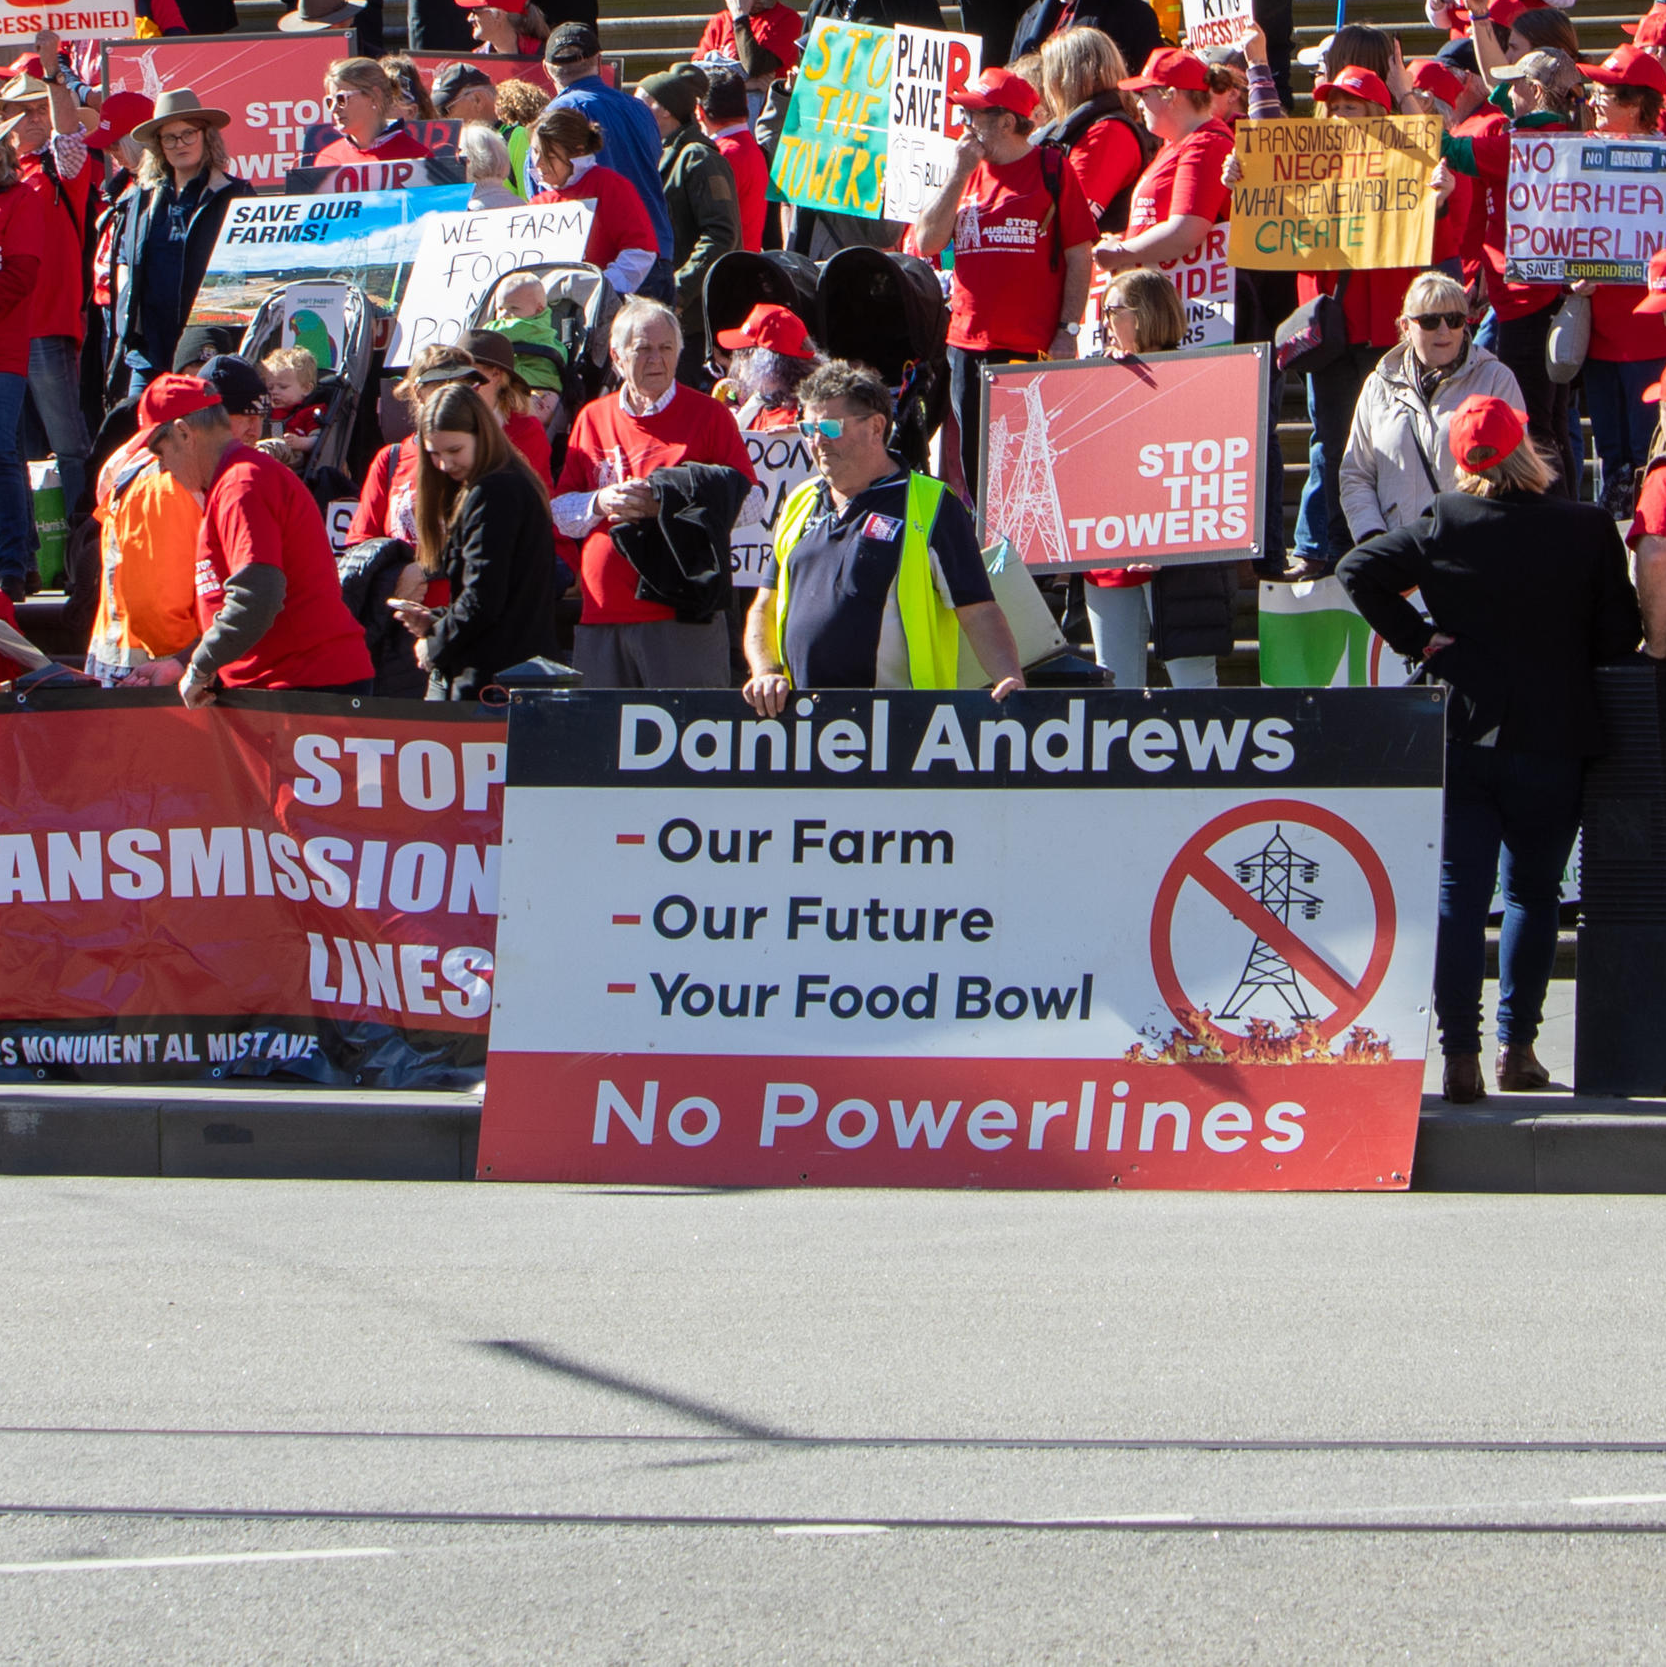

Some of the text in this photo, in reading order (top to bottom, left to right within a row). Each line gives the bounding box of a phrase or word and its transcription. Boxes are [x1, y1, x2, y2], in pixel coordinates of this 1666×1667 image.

[47, 11, 129, 31] DENIED
[894, 82, 941, 132] SAVE
[897, 34, 971, 141] PLAN B
[814, 85, 878, 142] THE
[1239, 118, 1436, 153] TRANSMISSION TOWERS
[334, 161, 414, 194] OUR
[775, 135, 885, 213] TOWERS
[1272, 151, 1386, 182] NEGATE
[1511, 141, 1555, 174] NO
[1585, 151, 1603, 166] NO
[232, 200, 362, 224] SAVE OUR
[1234, 178, 1420, 218] WHAT RENEWABLES
[225, 223, 330, 245] FARMS!
[441, 210, 584, 245] WE FARM
[987, 234, 1036, 244] TOWERS
[1005, 217, 1038, 227] STOP
[1254, 216, 1366, 256] CREATE
[1526, 260, 1643, 278] SAVE LERDERDERG
[1139, 436, 1249, 477] STOP
[1162, 472, 1247, 508] THE
[1069, 506, 1247, 551] TOWERS
[619, 699, 1295, 773] Daniel Andrews
[292, 735, 507, 812] STOP
[657, 818, 955, 865] Our Farm
[652, 894, 994, 942] Our Future
[307, 933, 494, 1019] LINES
[650, 972, 1094, 1021] Your Food Bowl
[592, 1078, 1306, 1156] No Powerlines
